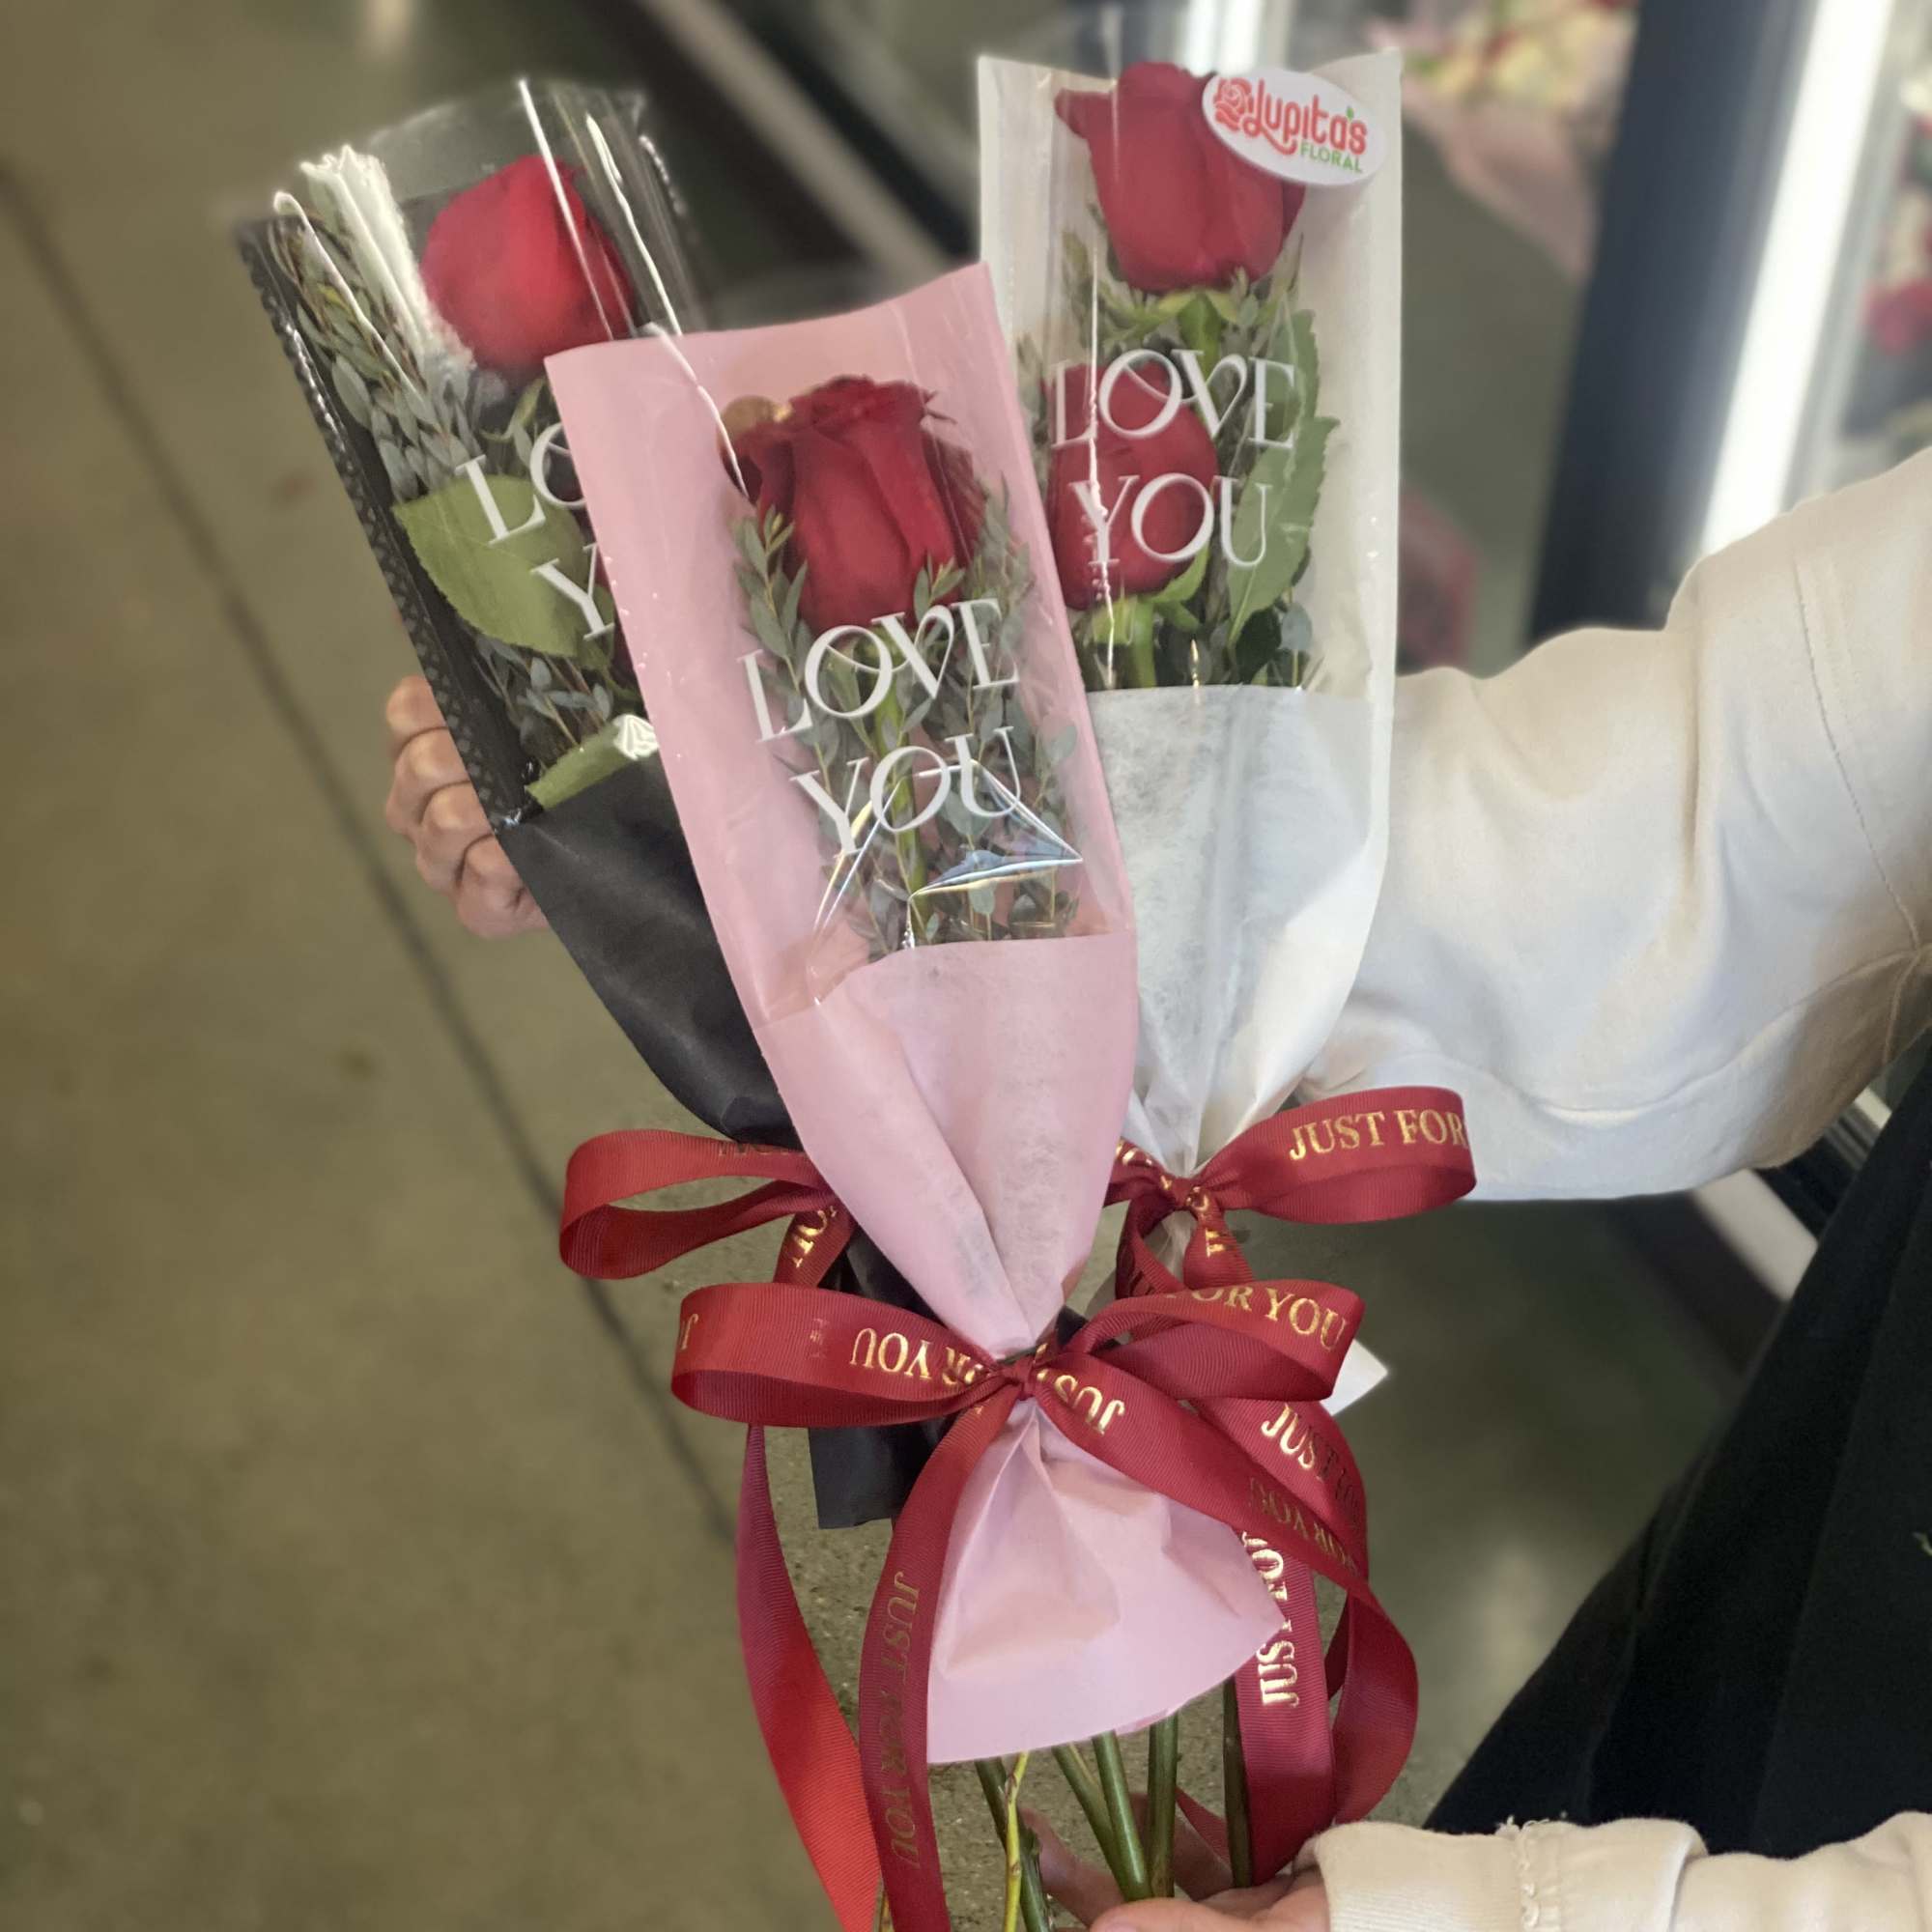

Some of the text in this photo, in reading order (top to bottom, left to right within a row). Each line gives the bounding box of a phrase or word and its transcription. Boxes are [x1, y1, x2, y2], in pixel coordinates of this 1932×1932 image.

[1300, 143, 1363, 174] FLORAL
[1051, 349, 1294, 449] LOVE
[1068, 472, 1272, 568] YOU
[737, 597, 1020, 742] LOVE
[788, 725, 1021, 858] YOU
[1288, 1109, 1470, 1162] JUST FOR
[850, 1327, 931, 1379] YOU
[1264, 1287, 1350, 1352] YOU
[1037, 1367, 1125, 1436] JUS
[882, 1571, 921, 1686] JUST
[1256, 1618, 1299, 1708] JUS
